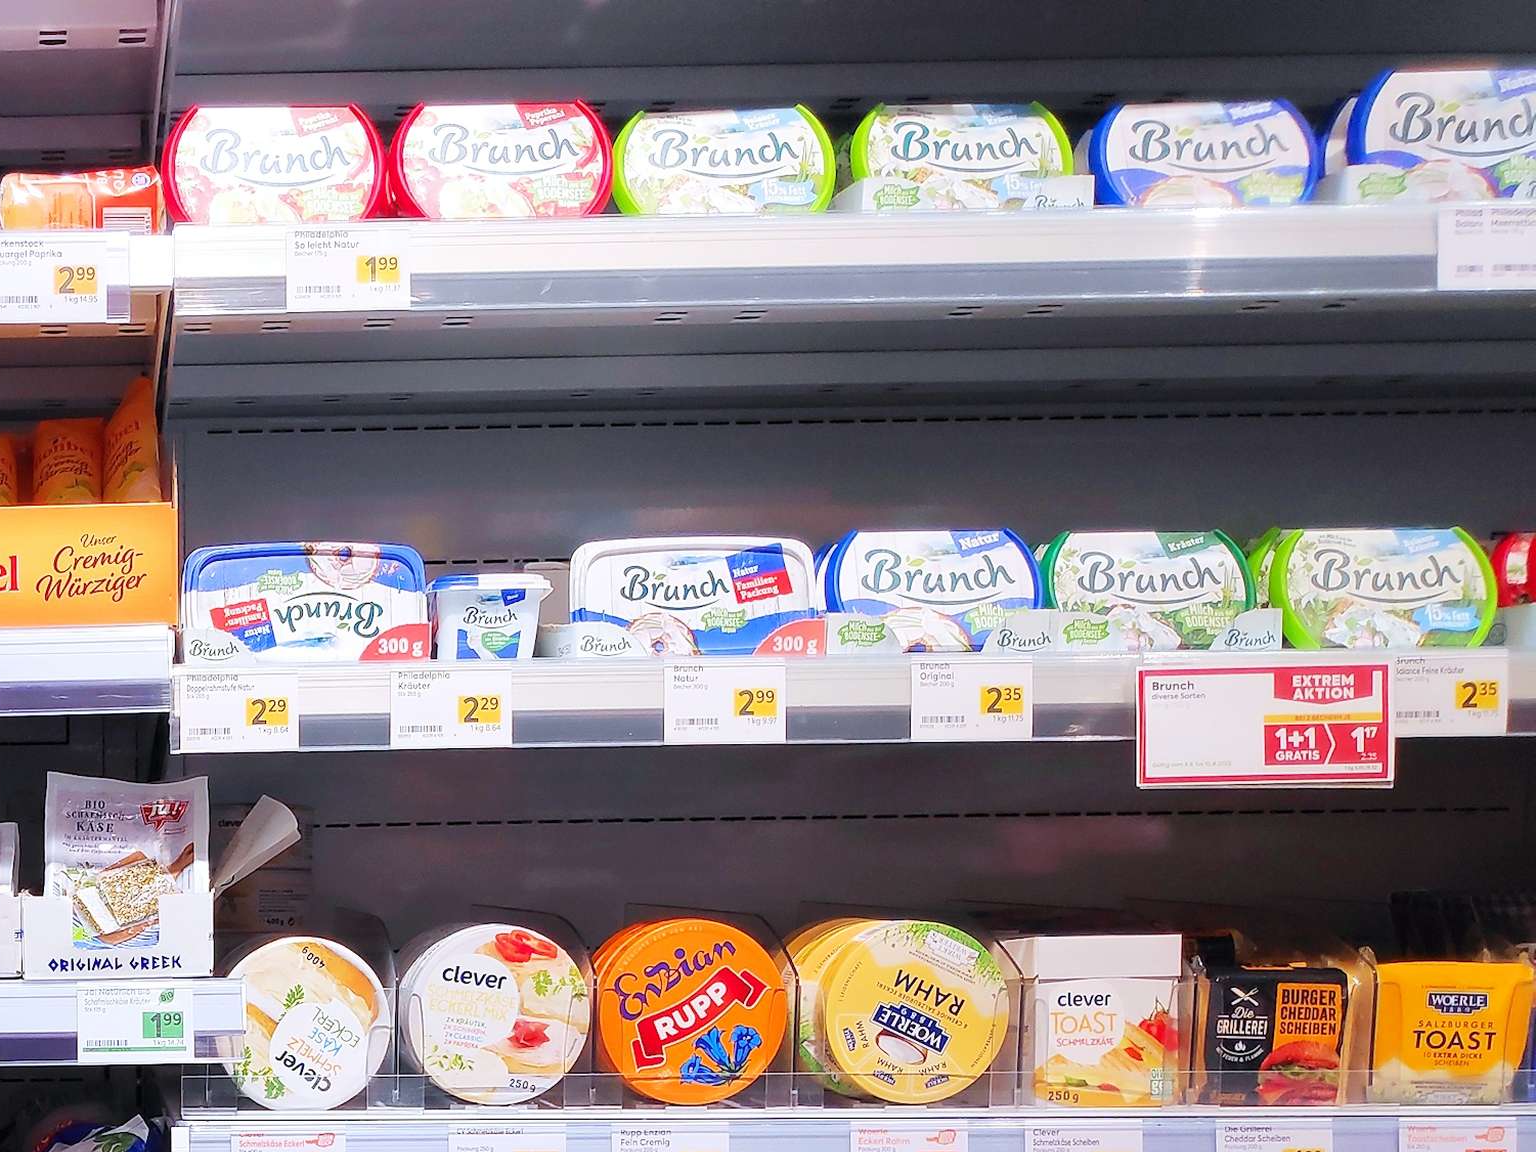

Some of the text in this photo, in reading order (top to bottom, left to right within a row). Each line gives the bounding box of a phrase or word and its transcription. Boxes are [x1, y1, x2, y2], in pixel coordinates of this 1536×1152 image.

[429, 123, 580, 164] Brunch
[648, 128, 800, 170] Brunch
[889, 121, 1039, 164] Brunch
[35, 571, 147, 602] Würziger
[1152, 680, 1195, 690] Brunch
[1292, 674, 1355, 688] EXTREM
[1293, 687, 1355, 700] AKTION
[1275, 727, 1316, 750] 1+1
[1275, 750, 1321, 762] GRATIS
[48, 954, 181, 972] ORIGINAL GREEK
[895, 968, 965, 1009] RAHM
[1281, 988, 1336, 1006] BURGER
[1431, 994, 1485, 1006] WOERLE
[654, 981, 728, 1040] RUPP
[1280, 1008, 1336, 1021] CHEDDAR
[1051, 1011, 1118, 1034] TOAST
[1216, 1019, 1267, 1035] GRILLEREI
[1279, 1022, 1336, 1035] SCHEIBEN
[1413, 1031, 1496, 1050] TOAST
